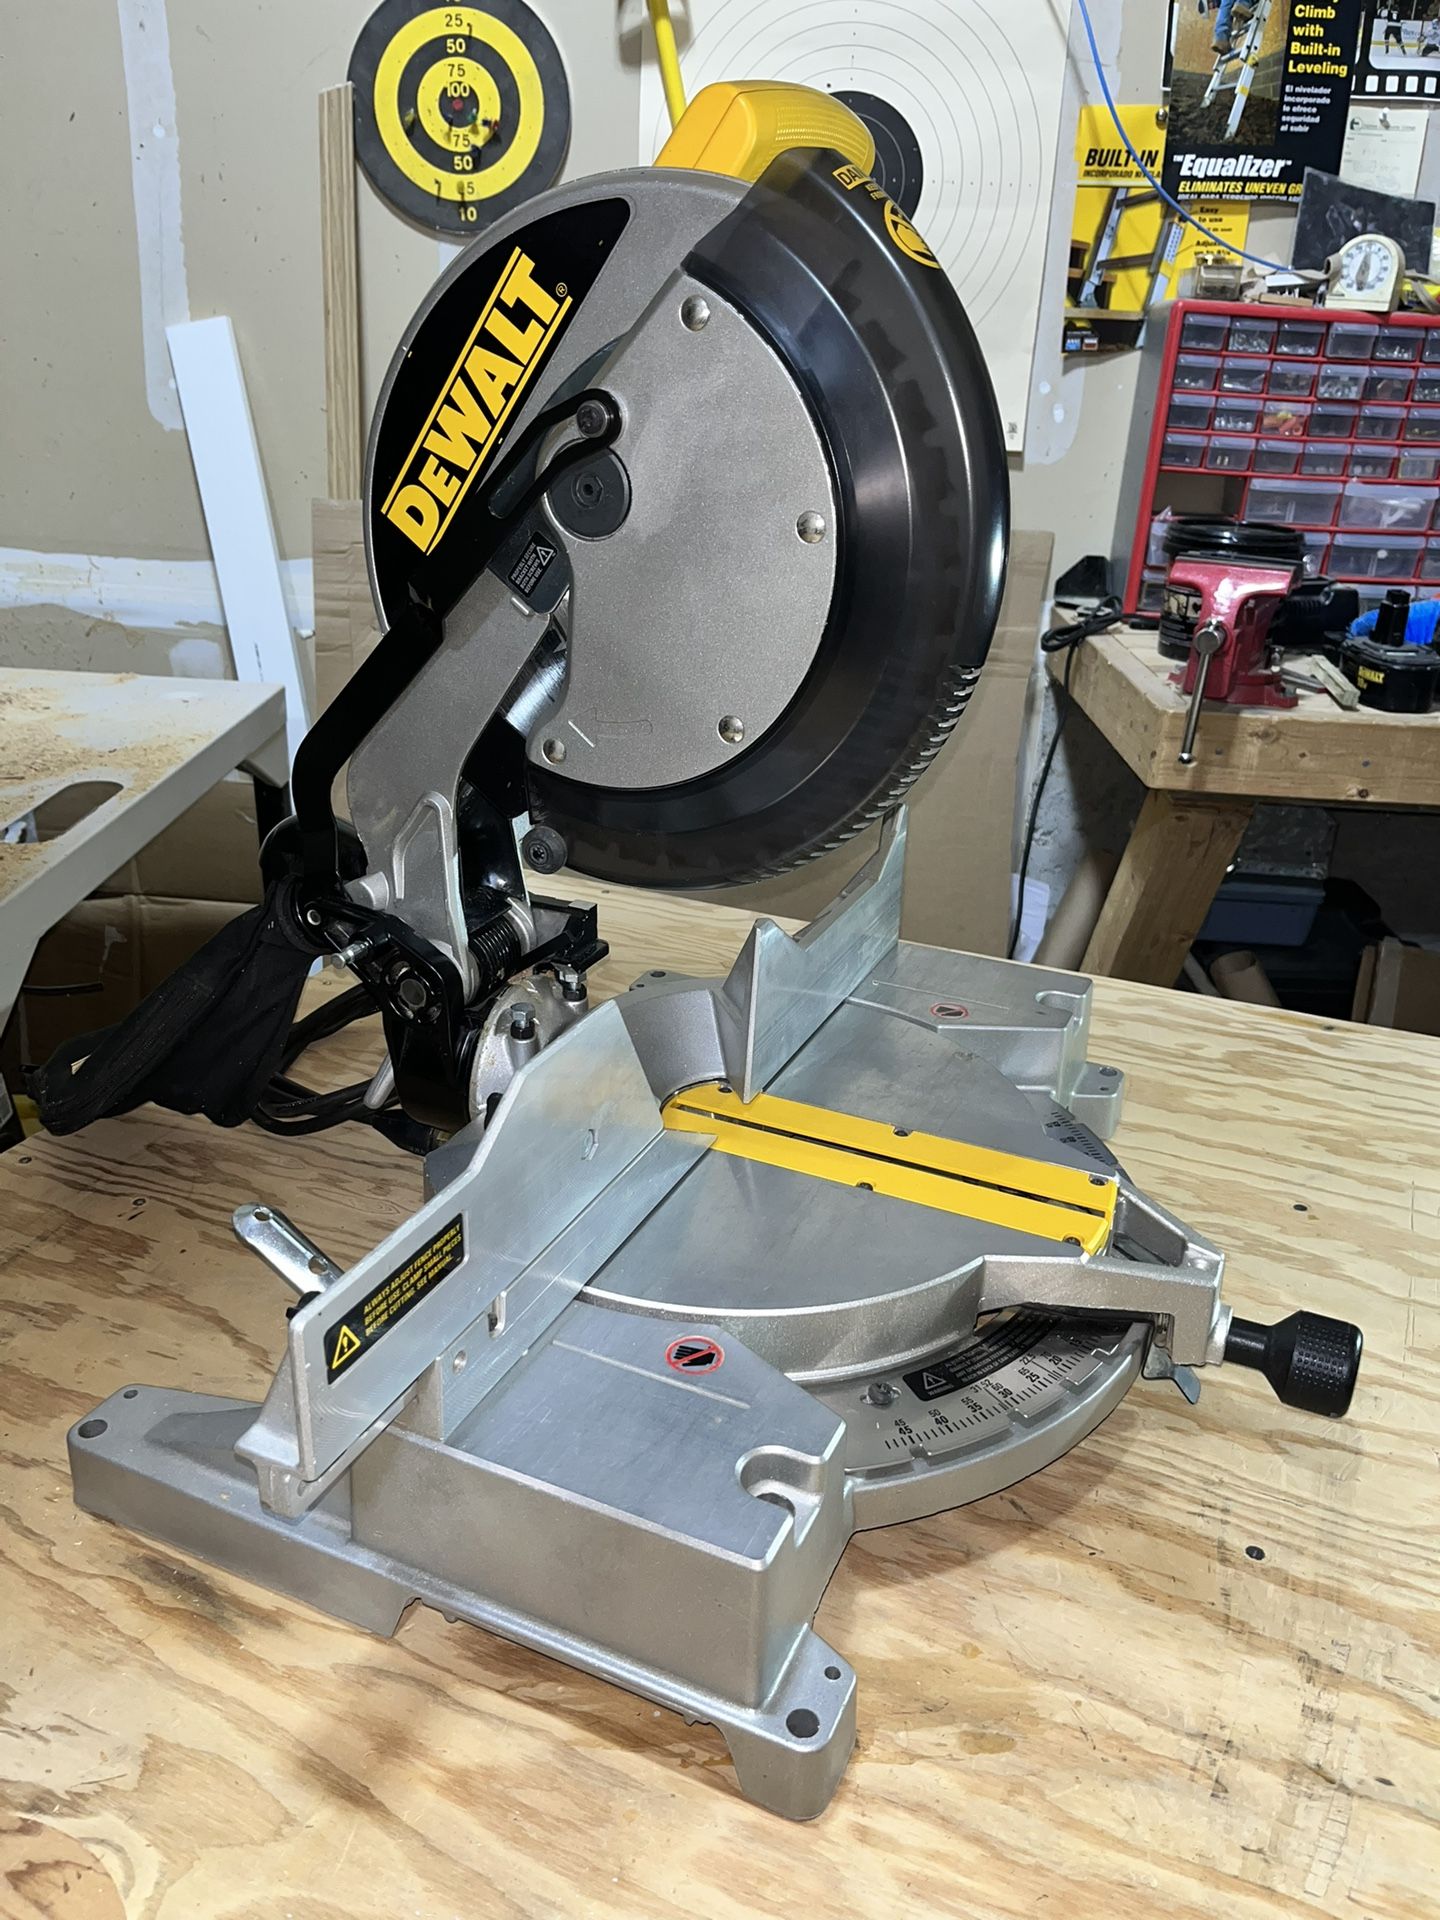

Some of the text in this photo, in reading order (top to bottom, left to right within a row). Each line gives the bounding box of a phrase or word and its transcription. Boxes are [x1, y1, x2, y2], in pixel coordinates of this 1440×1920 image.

[1294, 4, 1336, 19] Climb
[444, 13, 464, 28] 25
[1293, 24, 1324, 37] with
[446, 38, 466, 54] 50
[1290, 42, 1341, 57] Built-in
[447, 63, 466, 78] 75
[1288, 59, 1348, 77] Leveling
[446, 82, 471, 98] 100
[1285, 84, 1332, 95] El nivelador
[1284, 94, 1331, 105] incorporado
[1281, 114, 1320, 124] seguridad
[1289, 124, 1310, 133] subir
[453, 134, 471, 148] 75
[453, 154, 474, 171] 50
[1084, 148, 1159, 167] BUILT-IN
[1180, 154, 1284, 179] Equalizer
[1178, 180, 1244, 193] ELIMINATES
[1244, 181, 1286, 194] UNEVEN
[459, 207, 478, 222] 10
[1200, 206, 1220, 215] Easy
[363, 1223, 462, 1315] ALWAYS ADJUST FENCE PROPERLY
[364, 1301, 388, 1327] BEFORE
[402, 1268, 425, 1292] CLAMP
[423, 1251, 443, 1273] SMALL
[442, 1233, 462, 1255] PIECES
[365, 1312, 389, 1336] BEFORE
[1048, 1355, 1062, 1366] 20
[1025, 1372, 1040, 1383] 25
[998, 1388, 1013, 1399] 30
[967, 1402, 983, 1413] 35
[934, 1415, 949, 1426] 40
[897, 1425, 913, 1436] 45
